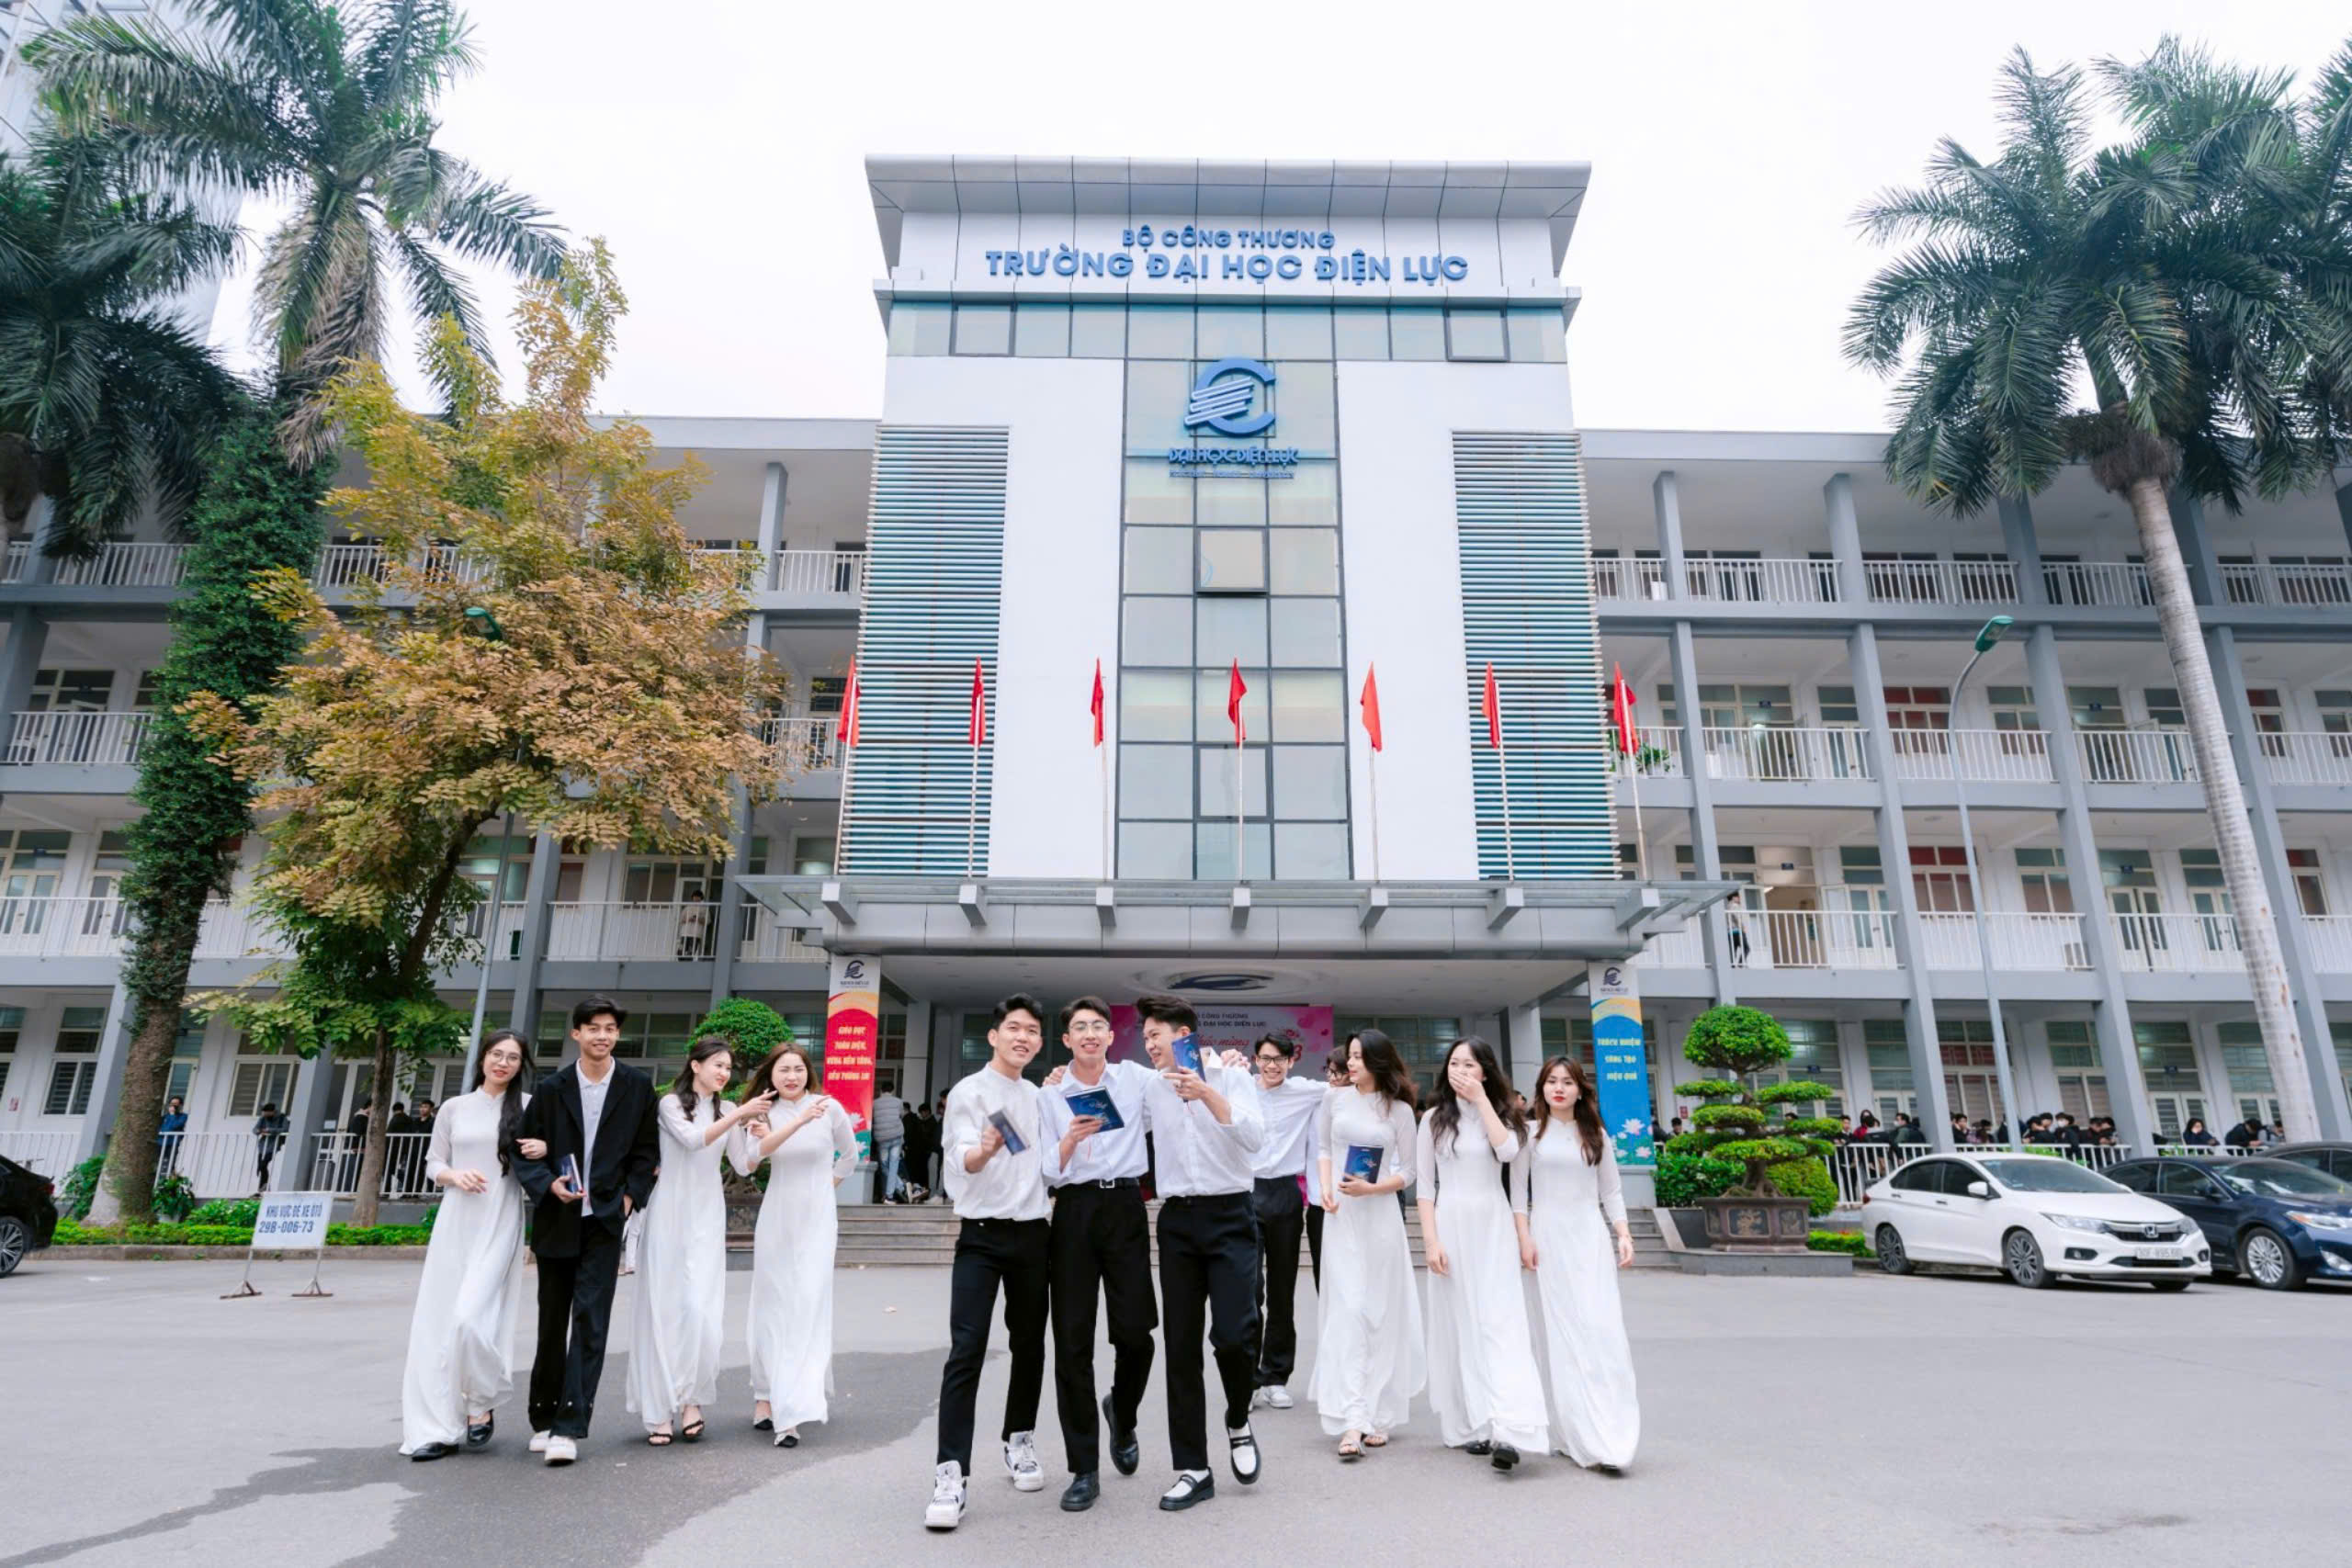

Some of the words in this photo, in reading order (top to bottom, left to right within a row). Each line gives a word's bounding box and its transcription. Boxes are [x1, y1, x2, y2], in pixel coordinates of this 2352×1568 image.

[1123, 225, 1154, 253] BỘ
[1161, 225, 1231, 249] CÔNG
[1238, 229, 1335, 250] THƯƠNG
[986, 243, 1134, 276] TRƯỜNG
[1147, 254, 1209, 284] ĐẠI
[1222, 254, 1303, 285] HỌC
[1314, 249, 1391, 286] ĐIỆN
[1403, 254, 1468, 287] LỰC
[1196, 448, 1236, 468] HỌC
